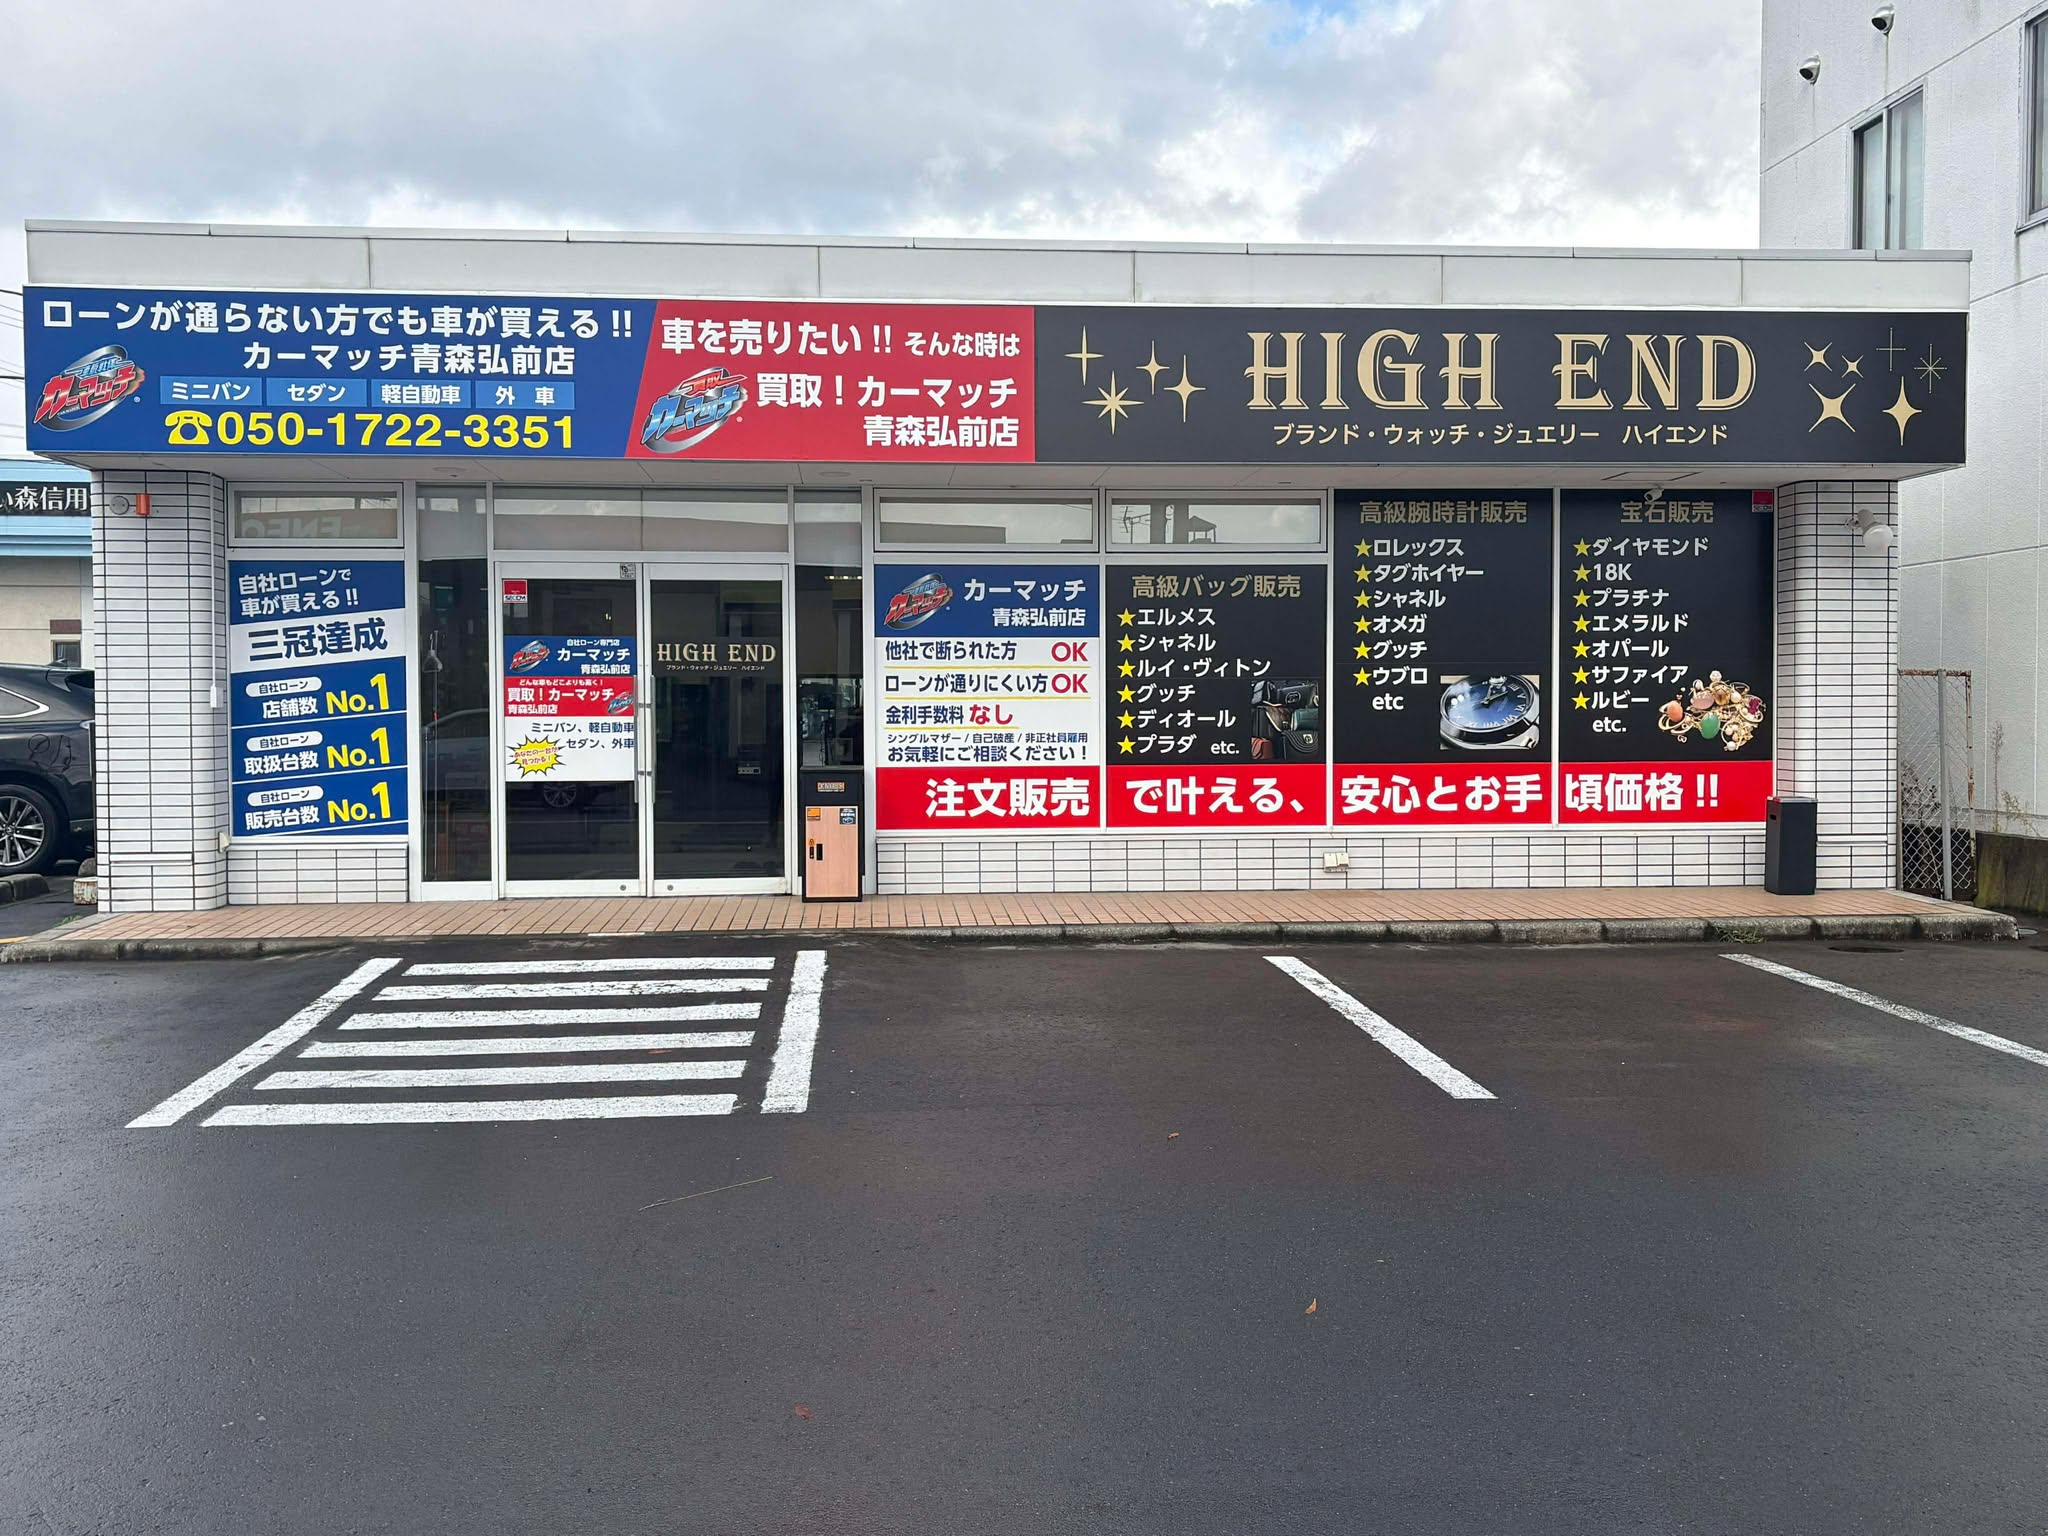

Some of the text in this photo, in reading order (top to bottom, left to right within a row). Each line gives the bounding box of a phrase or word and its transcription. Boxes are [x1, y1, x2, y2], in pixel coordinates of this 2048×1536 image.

[904, 331, 1021, 357] そんな時は
[243, 342, 577, 376] カーマッチ青森弘前店
[1244, 329, 1757, 411] HIGH END
[170, 381, 252, 400] ミニバン
[286, 382, 347, 401] セダン
[381, 384, 462, 405] 軽自動車
[217, 411, 574, 449] 050-1722-3351
[862, 414, 1020, 448] 青森弘前店
[1621, 422, 1729, 446] ハイエンド
[1359, 500, 1528, 524] 高級腕時計販売
[1620, 501, 1714, 524] 宝石販売
[1373, 538, 1465, 557] ロレックス
[1592, 537, 1709, 557] ダイヤモンド
[238, 567, 353, 596] 自社ローンで
[1373, 563, 1484, 583] タグホイヤー
[1593, 563, 1633, 581] 18K
[964, 578, 1087, 602] カーマッチ
[1131, 574, 1302, 599] 高級バッグ販売
[1373, 589, 1447, 608] シャネル
[1592, 588, 1669, 608] プラチナ
[991, 607, 1087, 627] 青森弘前店
[1137, 608, 1216, 626] エルメス
[1372, 613, 1428, 634] オメガ
[1592, 613, 1689, 634] エメラルド
[248, 616, 389, 662] 三冠達成
[1137, 633, 1217, 652] シャネル
[1372, 639, 1428, 659] グッチ
[1592, 639, 1669, 659] オパール
[557, 647, 631, 662] カーマッチ
[657, 643, 777, 662] HIGH END
[885, 640, 1088, 662] 他社で断られた方 OK
[580, 664, 631, 675] 青森弘前店
[1136, 657, 1271, 678] ルイ・ヴィトン
[1372, 666, 1428, 685] ウブロ
[1592, 665, 1688, 685] サファイア
[258, 680, 309, 695] 自社ローン
[885, 673, 1088, 694] ローンが通りにくい方 OK
[1136, 683, 1196, 703] グッチ
[262, 673, 390, 721] 店舗数 No.1
[1372, 693, 1405, 711] etc
[1591, 690, 1649, 710] ルビー
[507, 704, 558, 714] 青森弘前店
[885, 704, 1014, 725] 金利手数料 なし
[1136, 709, 1237, 729] ディオール
[1592, 716, 1627, 733] etc.
[259, 733, 310, 749] 自社ローン
[1137, 734, 1240, 755] プラダ etc.
[243, 727, 391, 776] 取扱台数 No.1
[887, 745, 1088, 763] お気軽にご相談ください！
[260, 788, 311, 804] 自社ローン
[924, 777, 1090, 818] 注文販売
[1126, 775, 1304, 816] で叶える、
[1341, 774, 1543, 815] 安心とお手
[245, 781, 392, 831] 販売台数 No.1
